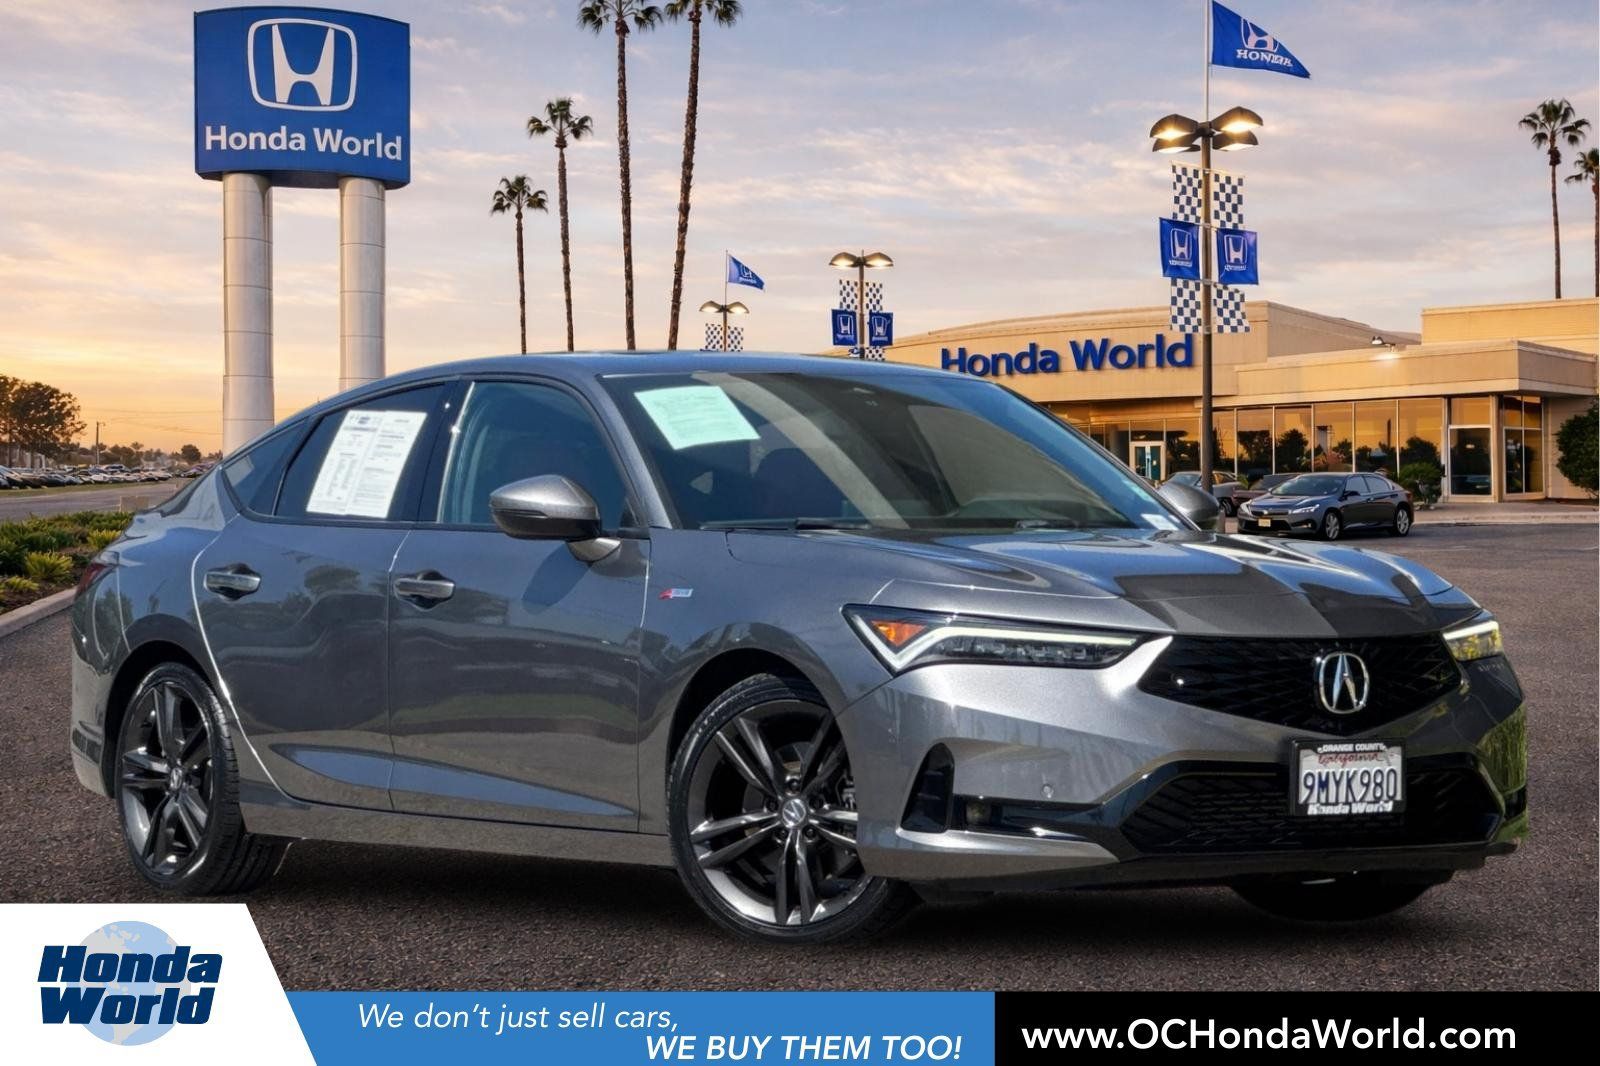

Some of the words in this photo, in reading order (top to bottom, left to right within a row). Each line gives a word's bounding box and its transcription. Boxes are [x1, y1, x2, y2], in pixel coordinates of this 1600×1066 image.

[205, 125, 306, 151] Honda
[313, 127, 402, 160] World
[941, 342, 1060, 377] Honda
[1069, 333, 1193, 371] World
[1303, 767, 1397, 804] 9MYK980
